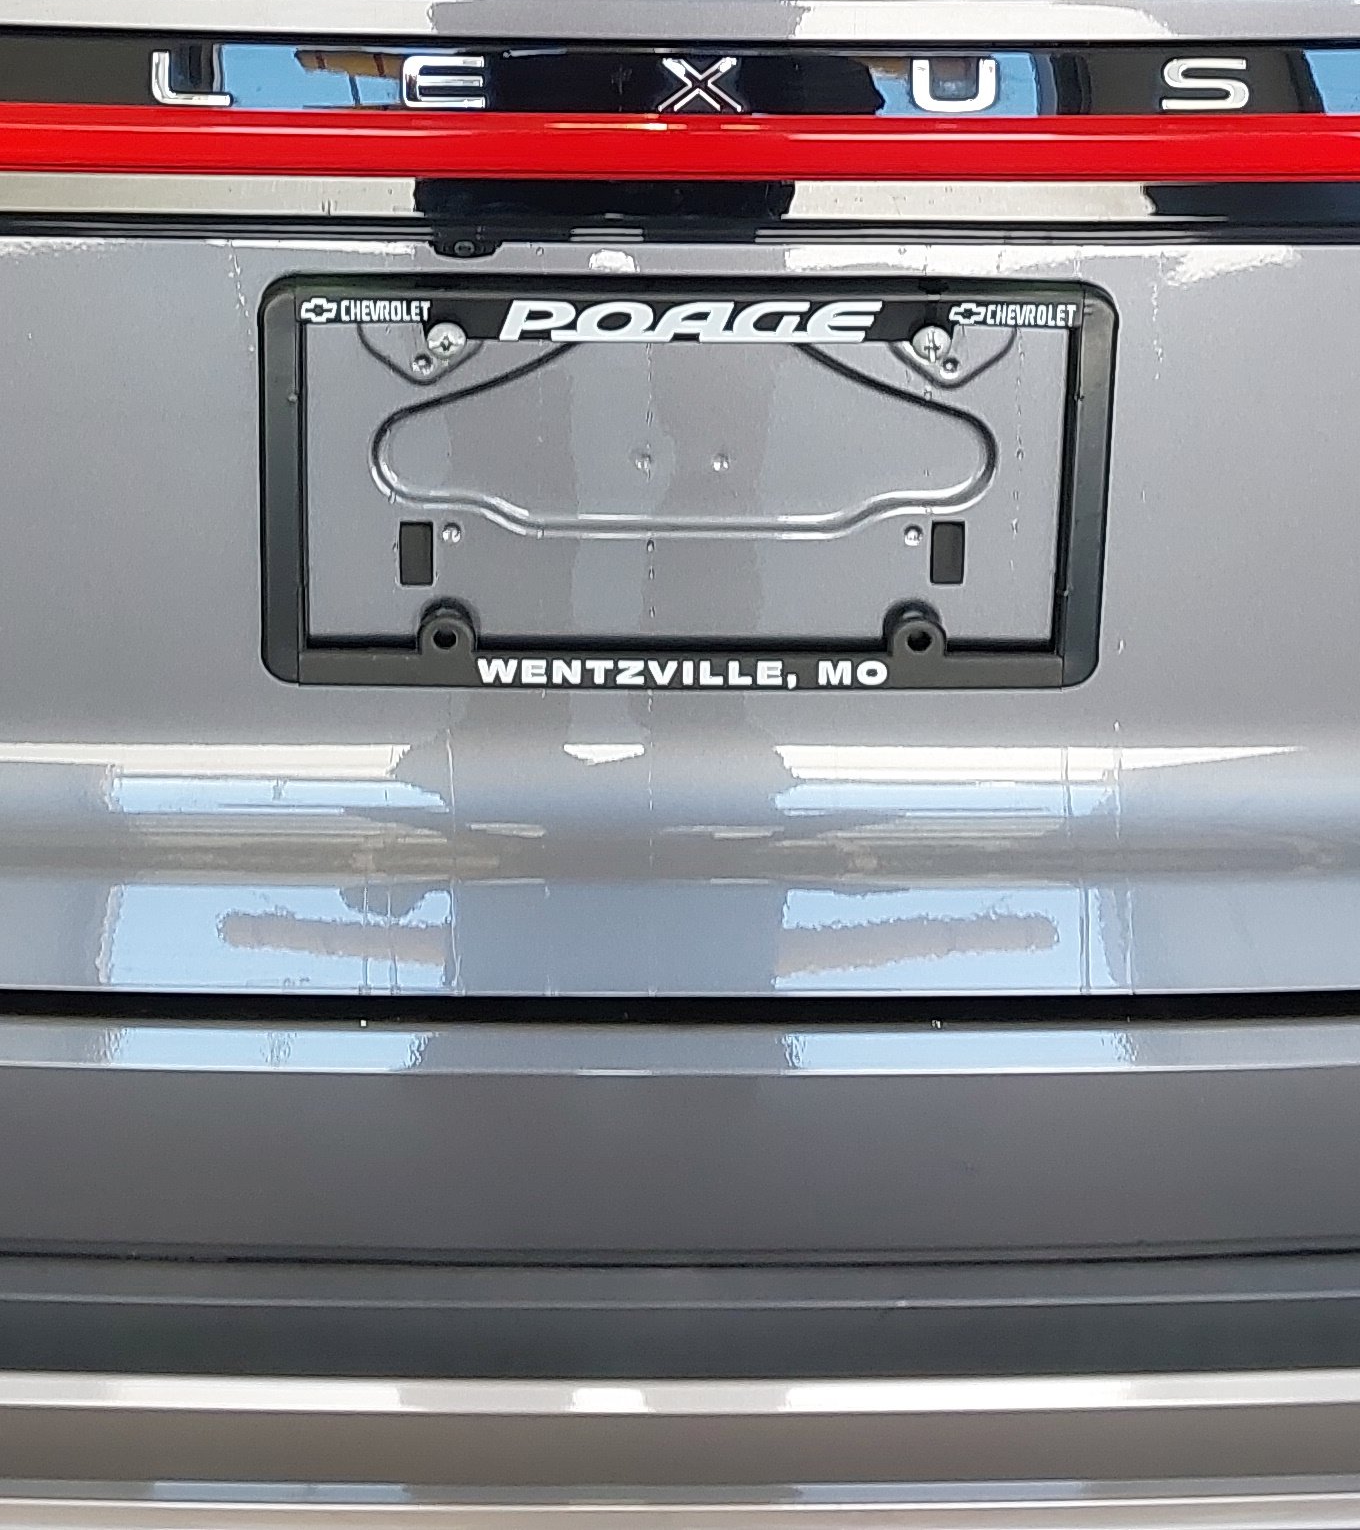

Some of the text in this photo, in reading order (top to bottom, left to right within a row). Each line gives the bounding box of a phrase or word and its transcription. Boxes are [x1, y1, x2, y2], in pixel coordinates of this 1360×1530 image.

[150, 50, 1250, 113] LEXUS
[340, 299, 431, 321] CHEVROLET
[499, 299, 885, 343] POAGE
[986, 303, 1077, 327] CHEVROLET
[477, 658, 889, 689] WENTZVILLE, MO
